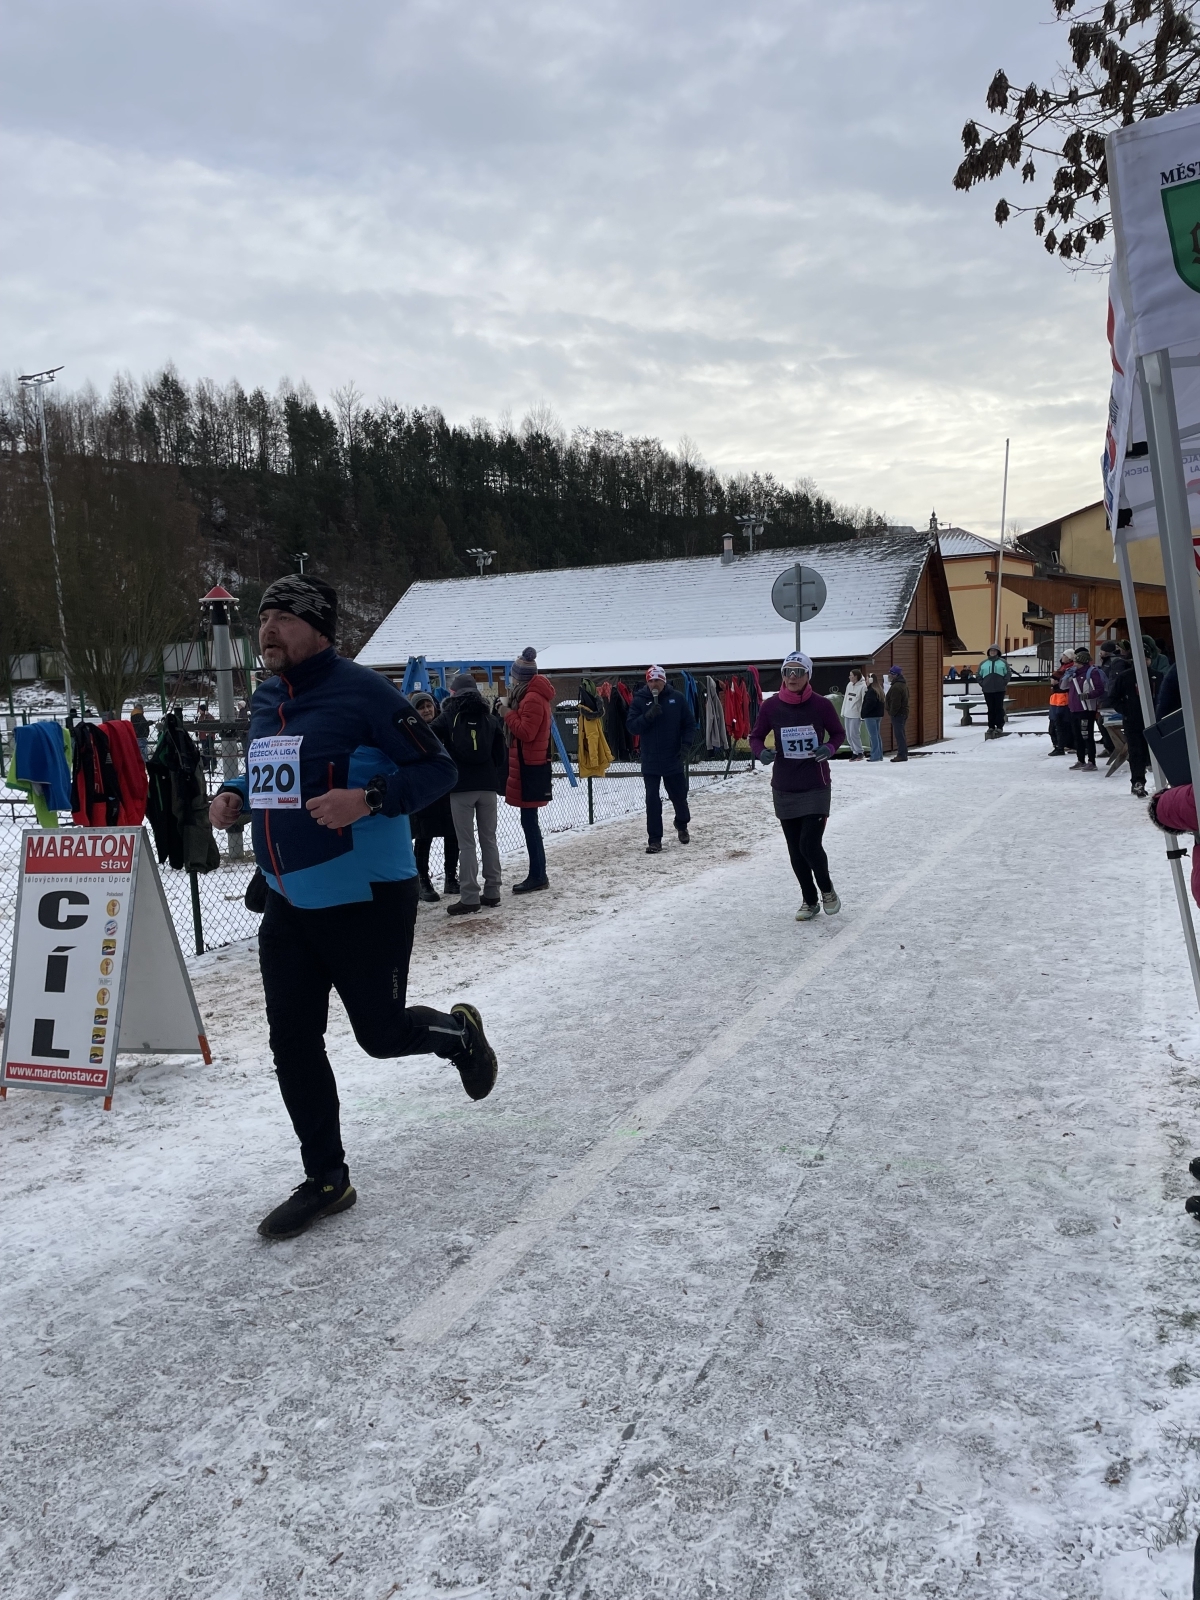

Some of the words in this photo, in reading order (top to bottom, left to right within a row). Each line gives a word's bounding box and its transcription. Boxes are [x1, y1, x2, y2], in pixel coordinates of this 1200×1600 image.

[787, 738, 814, 752] 313
[252, 763, 295, 794] 220
[26, 834, 135, 857] MARATON
[100, 859, 128, 869] stav
[25, 876, 73, 884] tělovýchovná
[75, 876, 105, 884] jednota
[108, 875, 131, 884] Úpice
[31, 890, 90, 1059] CÍL
[9, 1066, 104, 1083] www.maratonstav.cz
